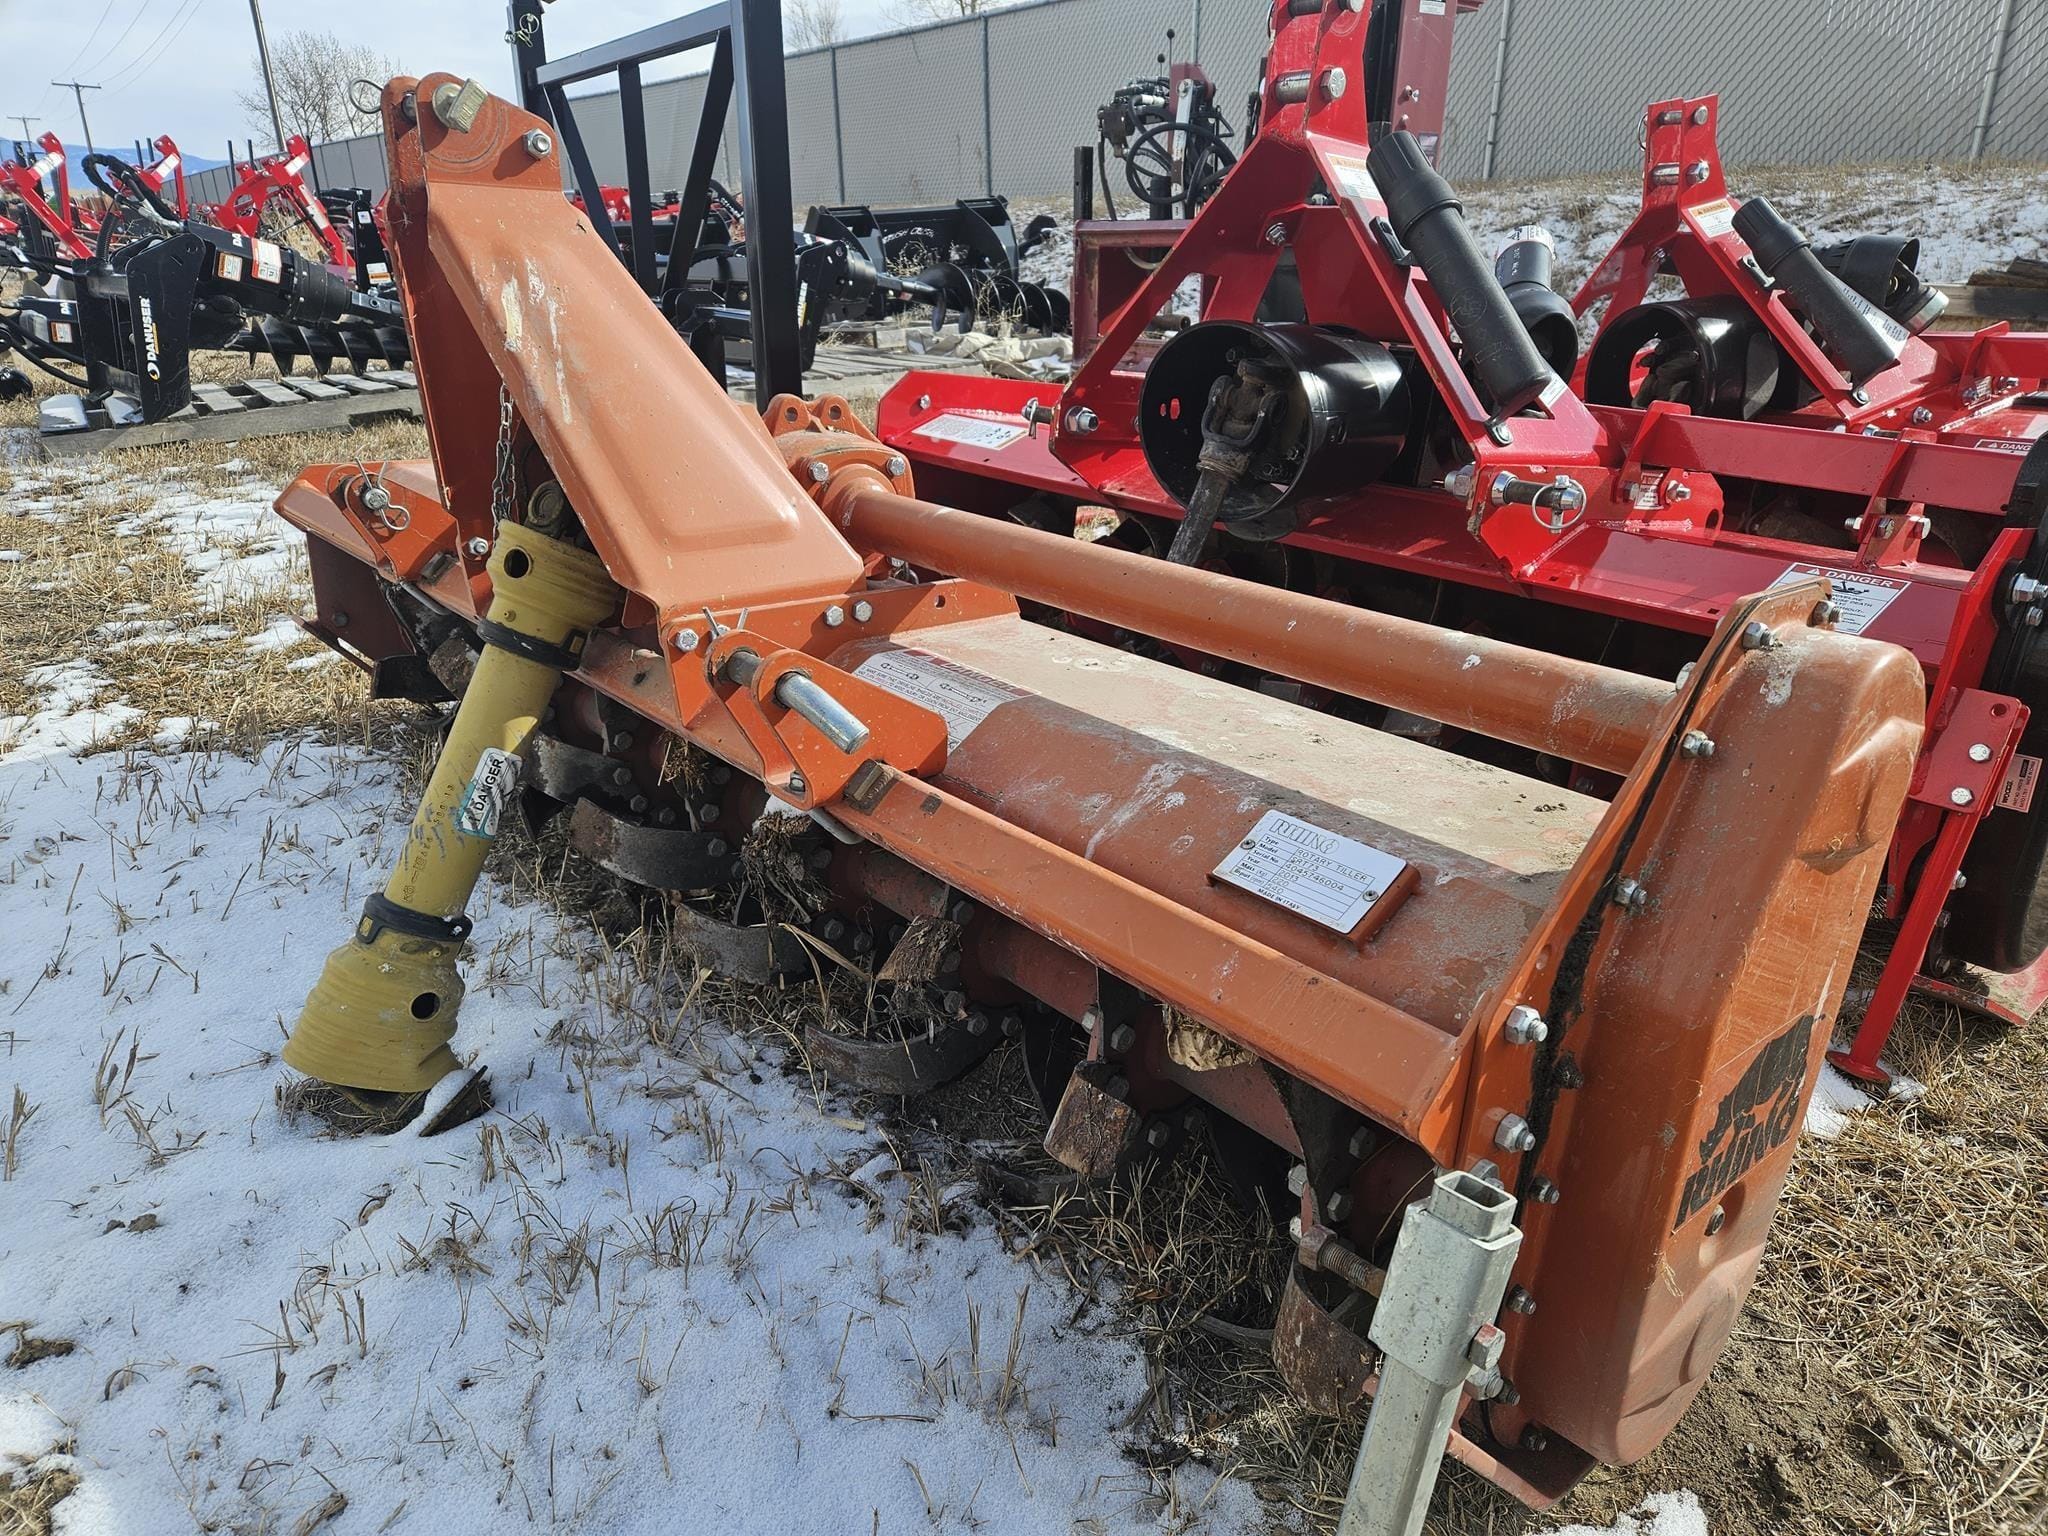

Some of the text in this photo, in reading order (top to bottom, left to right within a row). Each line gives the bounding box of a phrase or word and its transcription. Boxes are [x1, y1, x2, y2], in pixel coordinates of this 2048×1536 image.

[140, 297, 157, 361] DANUSER
[1825, 570, 1894, 588] DANGER
[940, 661, 1017, 692] DANGER
[475, 757, 505, 812] DANGER
[1259, 843, 1278, 854] Model
[1269, 818, 1339, 854] RHINO
[1247, 855, 1300, 882] Year 2013
[1253, 849, 1270, 859] Serial
[1265, 836, 1367, 881] Type ROTARY TILLER
[1258, 888, 1275, 899] MADE
[1282, 899, 1301, 910] ITALY
